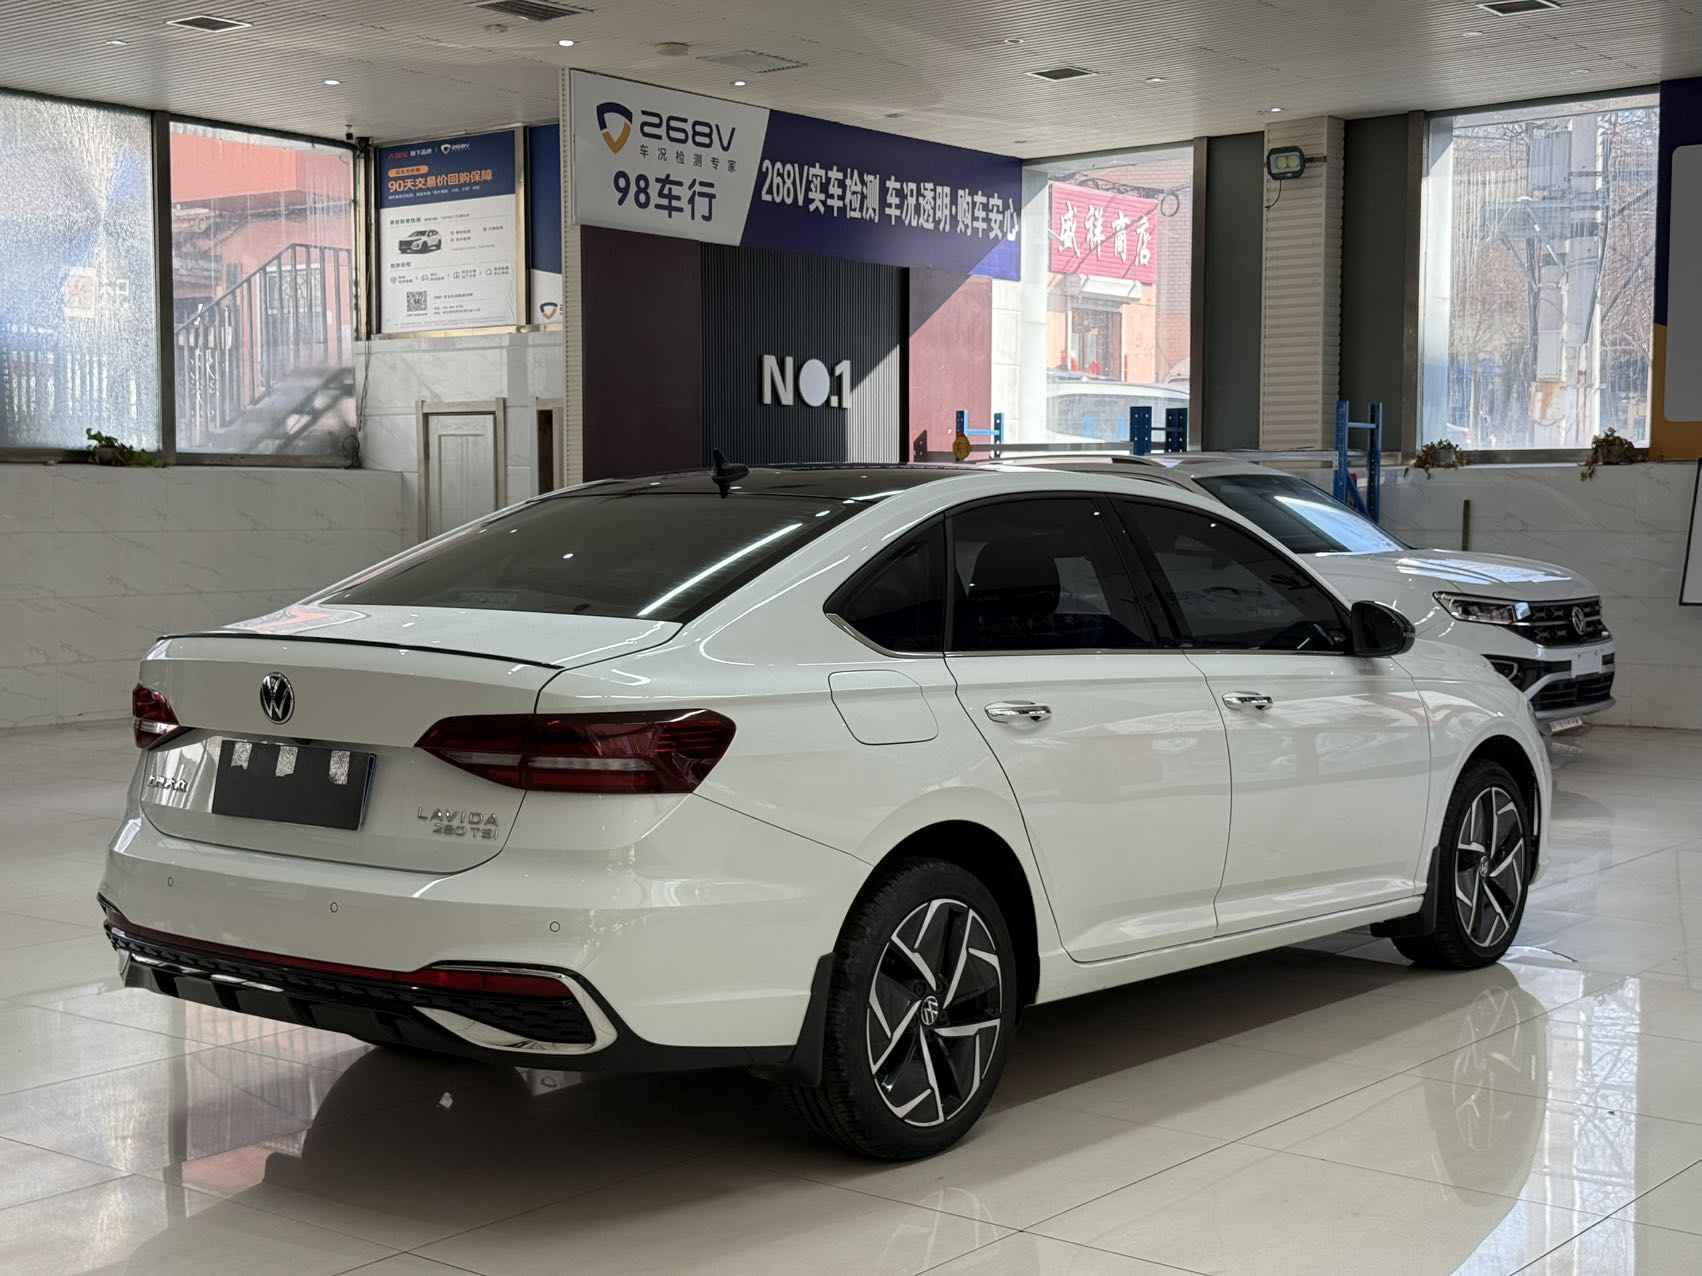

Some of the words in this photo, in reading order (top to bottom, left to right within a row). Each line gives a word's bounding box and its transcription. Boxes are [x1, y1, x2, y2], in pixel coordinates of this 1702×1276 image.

[639, 109, 737, 152] 268V
[638, 143, 738, 174] 车况检测专家
[388, 168, 493, 193] 90天交易价回购保障
[613, 170, 717, 222] 98车行
[761, 157, 880, 224] 268V实车检测
[885, 175, 1019, 242] 车况透明·购车安心
[416, 806, 500, 828] LAVIDA
[470, 826, 500, 841] TSI
